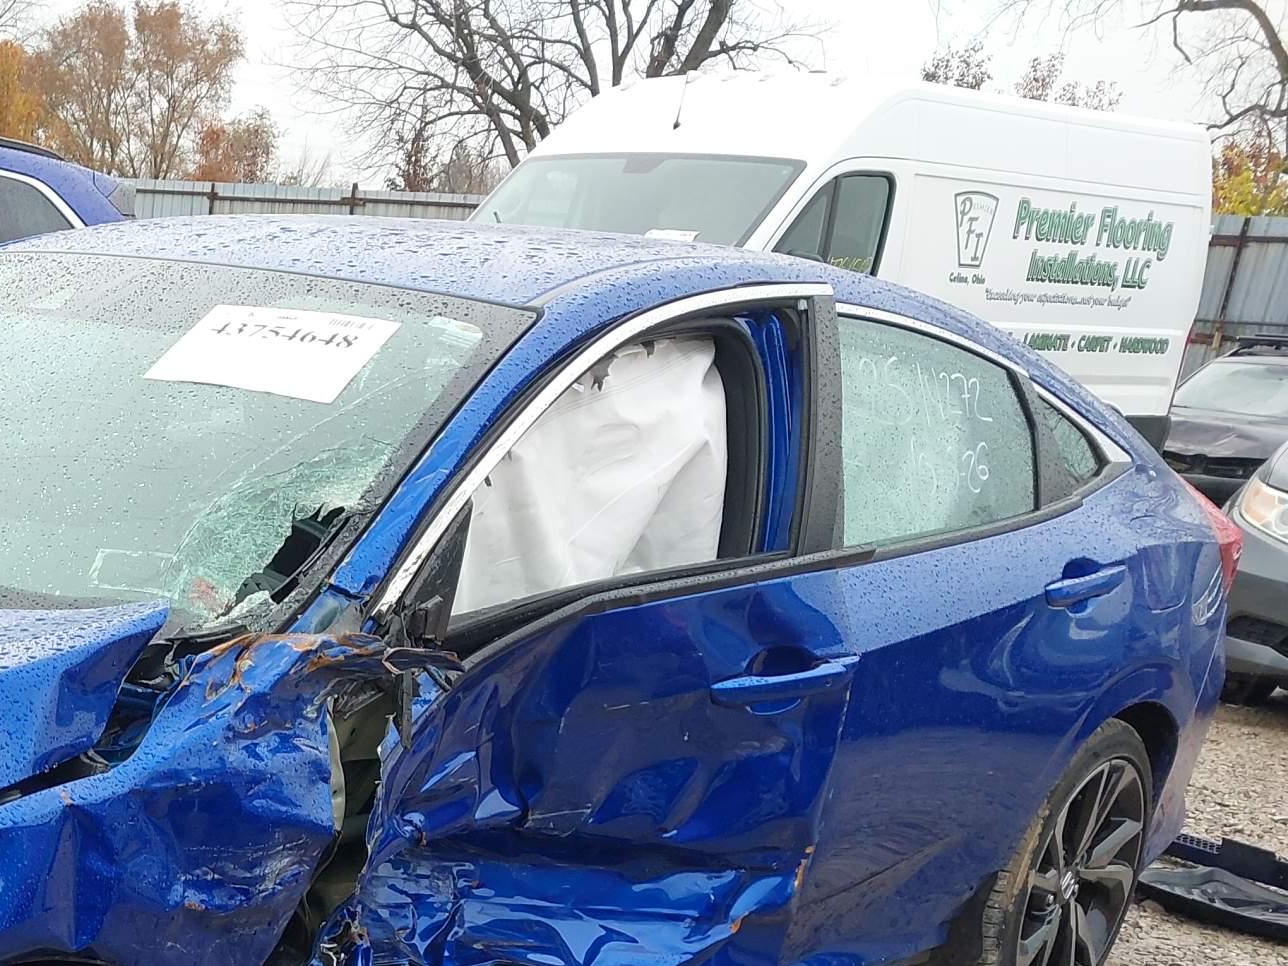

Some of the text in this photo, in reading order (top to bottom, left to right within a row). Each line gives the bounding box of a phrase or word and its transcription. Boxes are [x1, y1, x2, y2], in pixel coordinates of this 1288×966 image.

[1013, 196, 1175, 262] Premier Flooring
[971, 273, 986, 285] Ohio
[1026, 249, 1153, 291] Installations, LLC
[210, 321, 359, 349] 43754648
[1077, 334, 1114, 353] CARPET
[1119, 336, 1170, 355] HARDWOOD
